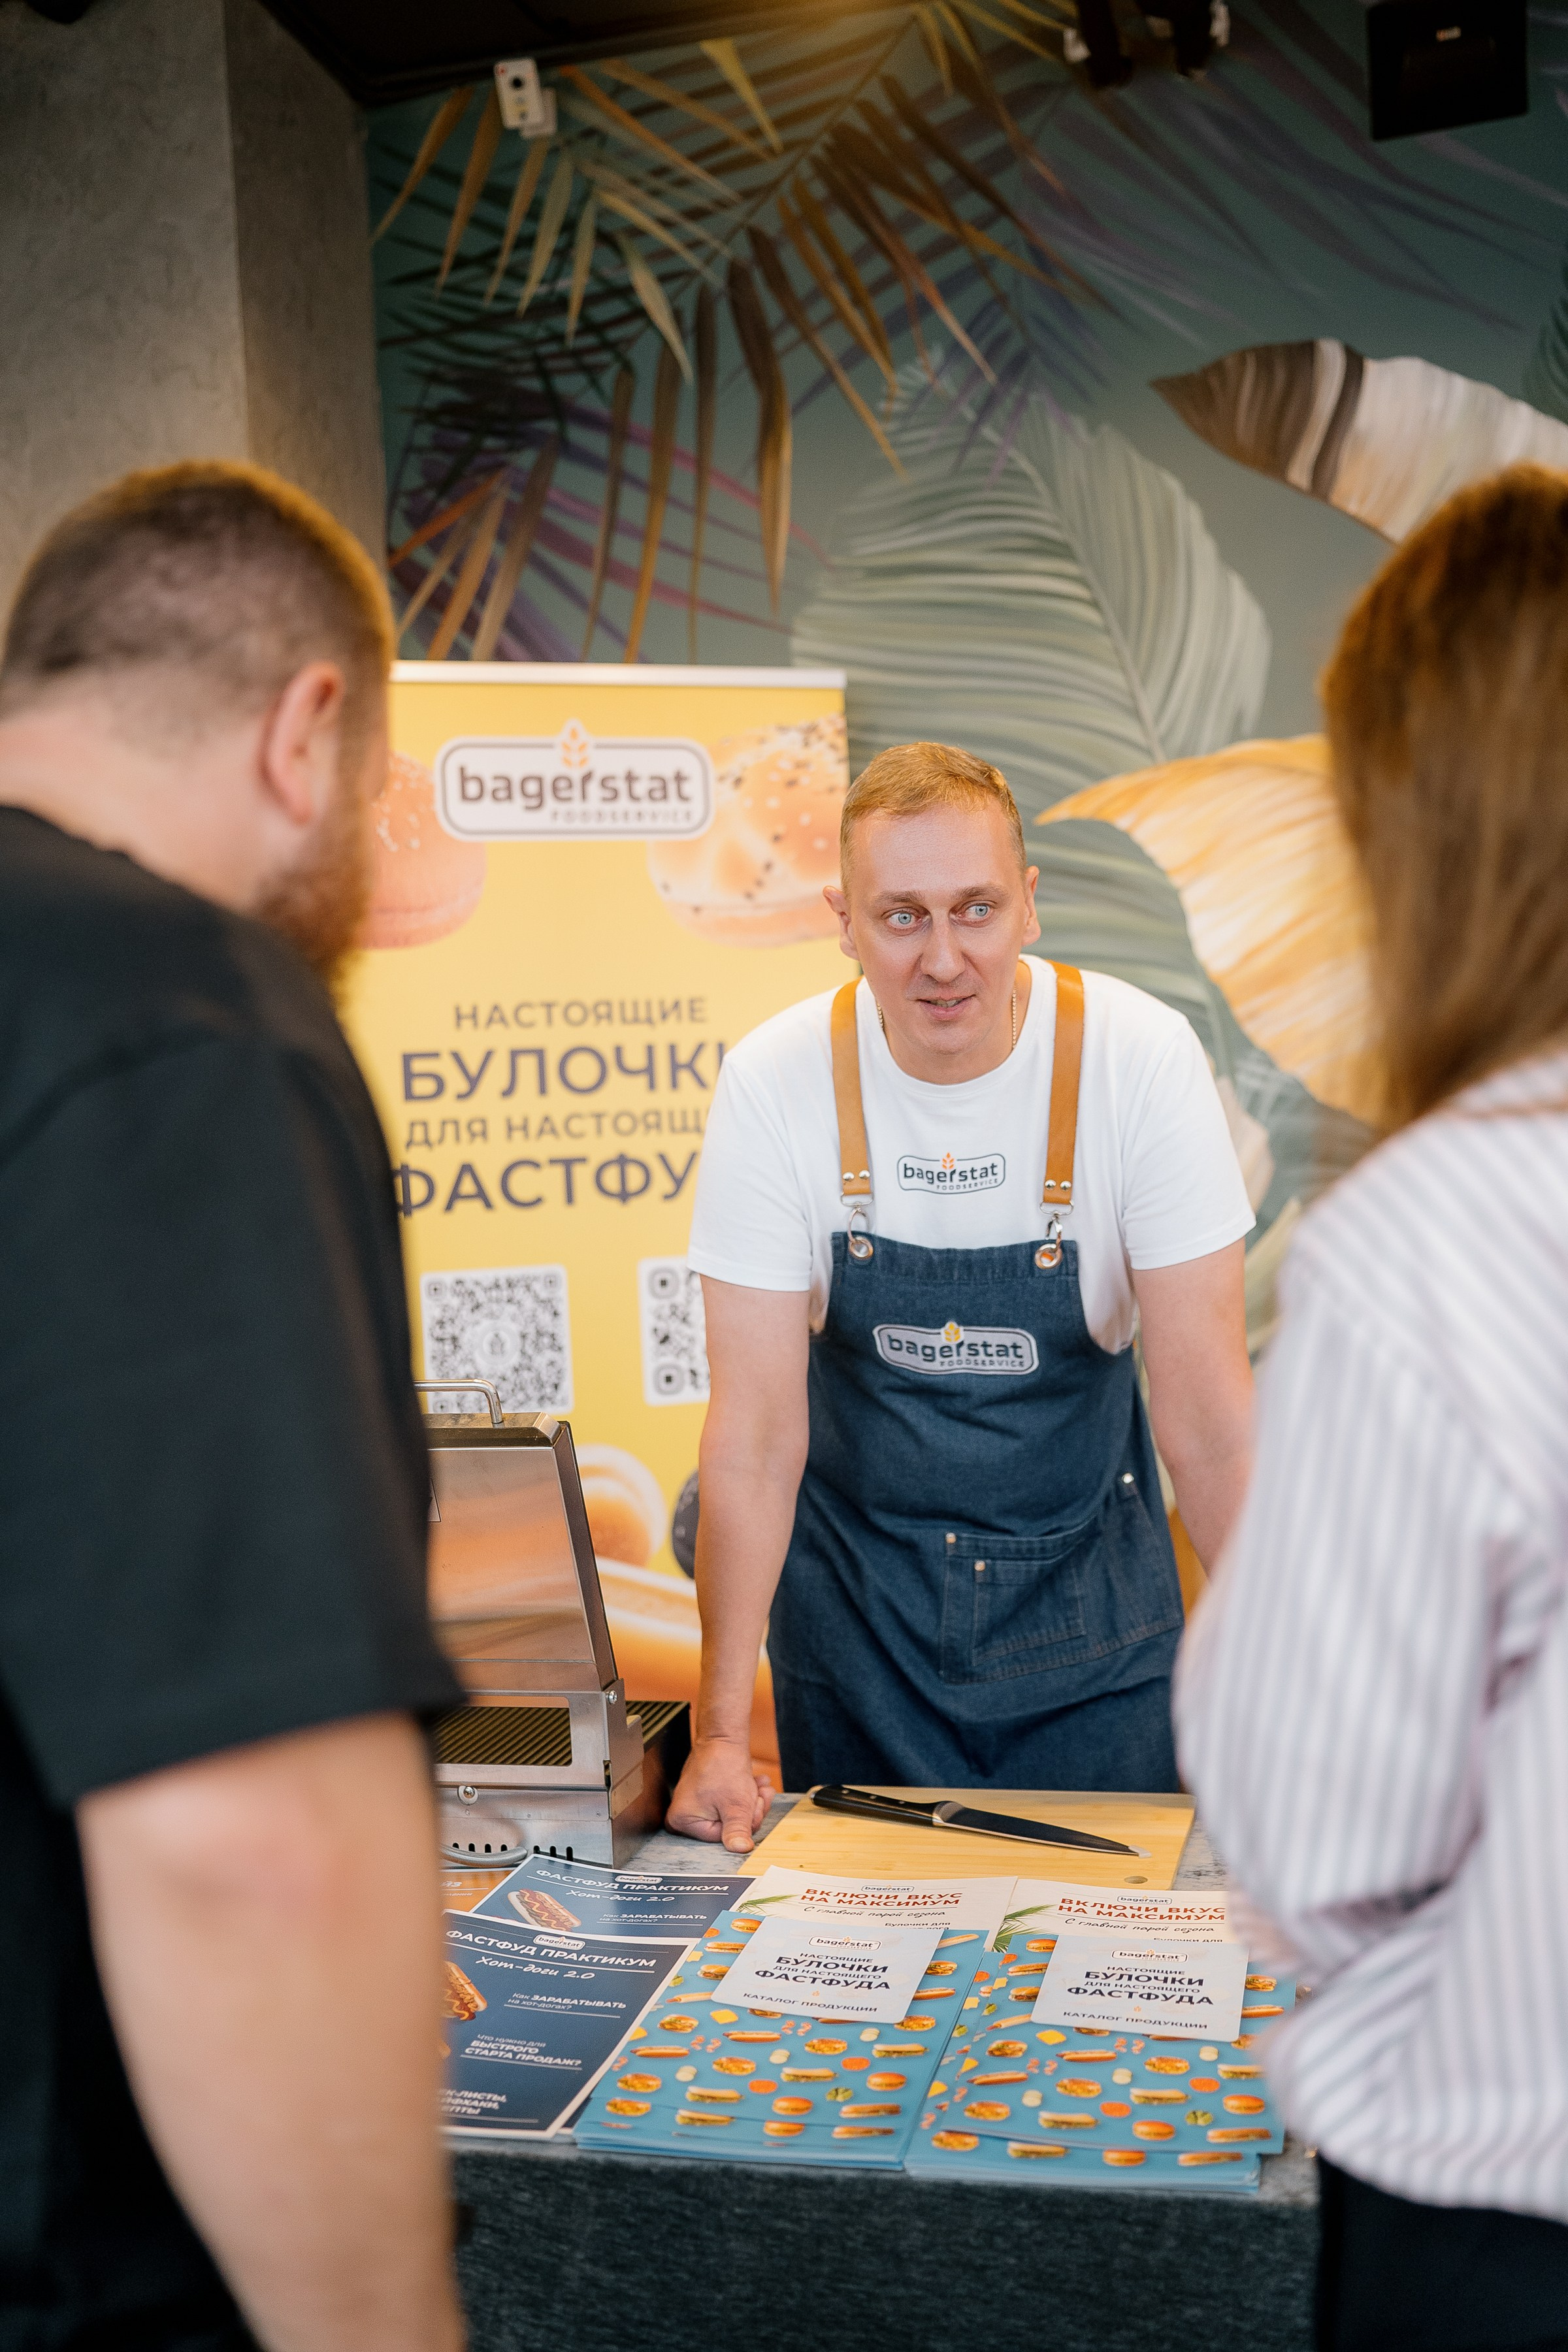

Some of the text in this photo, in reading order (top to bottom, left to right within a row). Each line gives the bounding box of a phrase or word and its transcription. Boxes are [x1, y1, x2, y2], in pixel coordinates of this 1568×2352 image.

[459, 766, 691, 811] bagerstat
[551, 809, 693, 825] FOODSERVICE
[455, 996, 709, 1032] НАСТОЯЩИЕ
[401, 1041, 725, 1103] БУЛОЧК
[405, 1107, 704, 1150] ДЛЯ НАСТОЯЩ
[904, 1162, 998, 1185] bagerstat
[394, 1151, 697, 1218] ФАСТФУ
[936, 1178, 998, 1190] FOODSERVICE
[887, 1334, 1024, 1363] bagerstat
[939, 1358, 1025, 1368] FOODSERVICE
[536, 1869, 619, 1889] ФАСТФУД
[565, 1889, 642, 1902] Хот-доги
[805, 1889, 899, 1900] ВКЛЮЧИ
[1058, 1905, 1225, 1920] НА МАКСИМУМ
[1060, 1898, 1158, 1912] ВКЛЮЧИ
[1078, 1921, 1128, 1929] главной
[446, 1929, 657, 1967] ФАСТФУД ПРАКТИКУМ
[538, 1937, 580, 1947] bagerstat
[816, 1938, 874, 1948] bagerstat
[776, 1956, 889, 1973] БУЛОЧКИ
[799, 1953, 874, 1963] НАСТОЯЩИЕ
[476, 1956, 596, 1980] Хот-доги 2.0
[801, 1967, 882, 1980] НАСТОЯЩЕГО
[1107, 1966, 1186, 1975] НАСТОЯЩИЕ
[755, 1970, 890, 1990] ФАСТФУДА
[1085, 1971, 1204, 1987] БУЛОЧКИ
[1115, 1982, 1201, 1993] НАСТОЯЩЕГО
[531, 1995, 627, 2009] ЗАРАБАТЫВАТЬ
[743, 1993, 878, 2012] КАТАЛОГ ПРОДУКЦИИ
[1067, 1987, 1214, 2005] ФАСТФУДА
[521, 2001, 572, 2010] хот-догах?
[1063, 2011, 1208, 2029] КАТАЛОГ ПРОДУКЦИИ
[470, 2040, 539, 2054] БЫСТРОГО
[465, 2047, 582, 2066] СТАРТА ПРОДАЖ?
